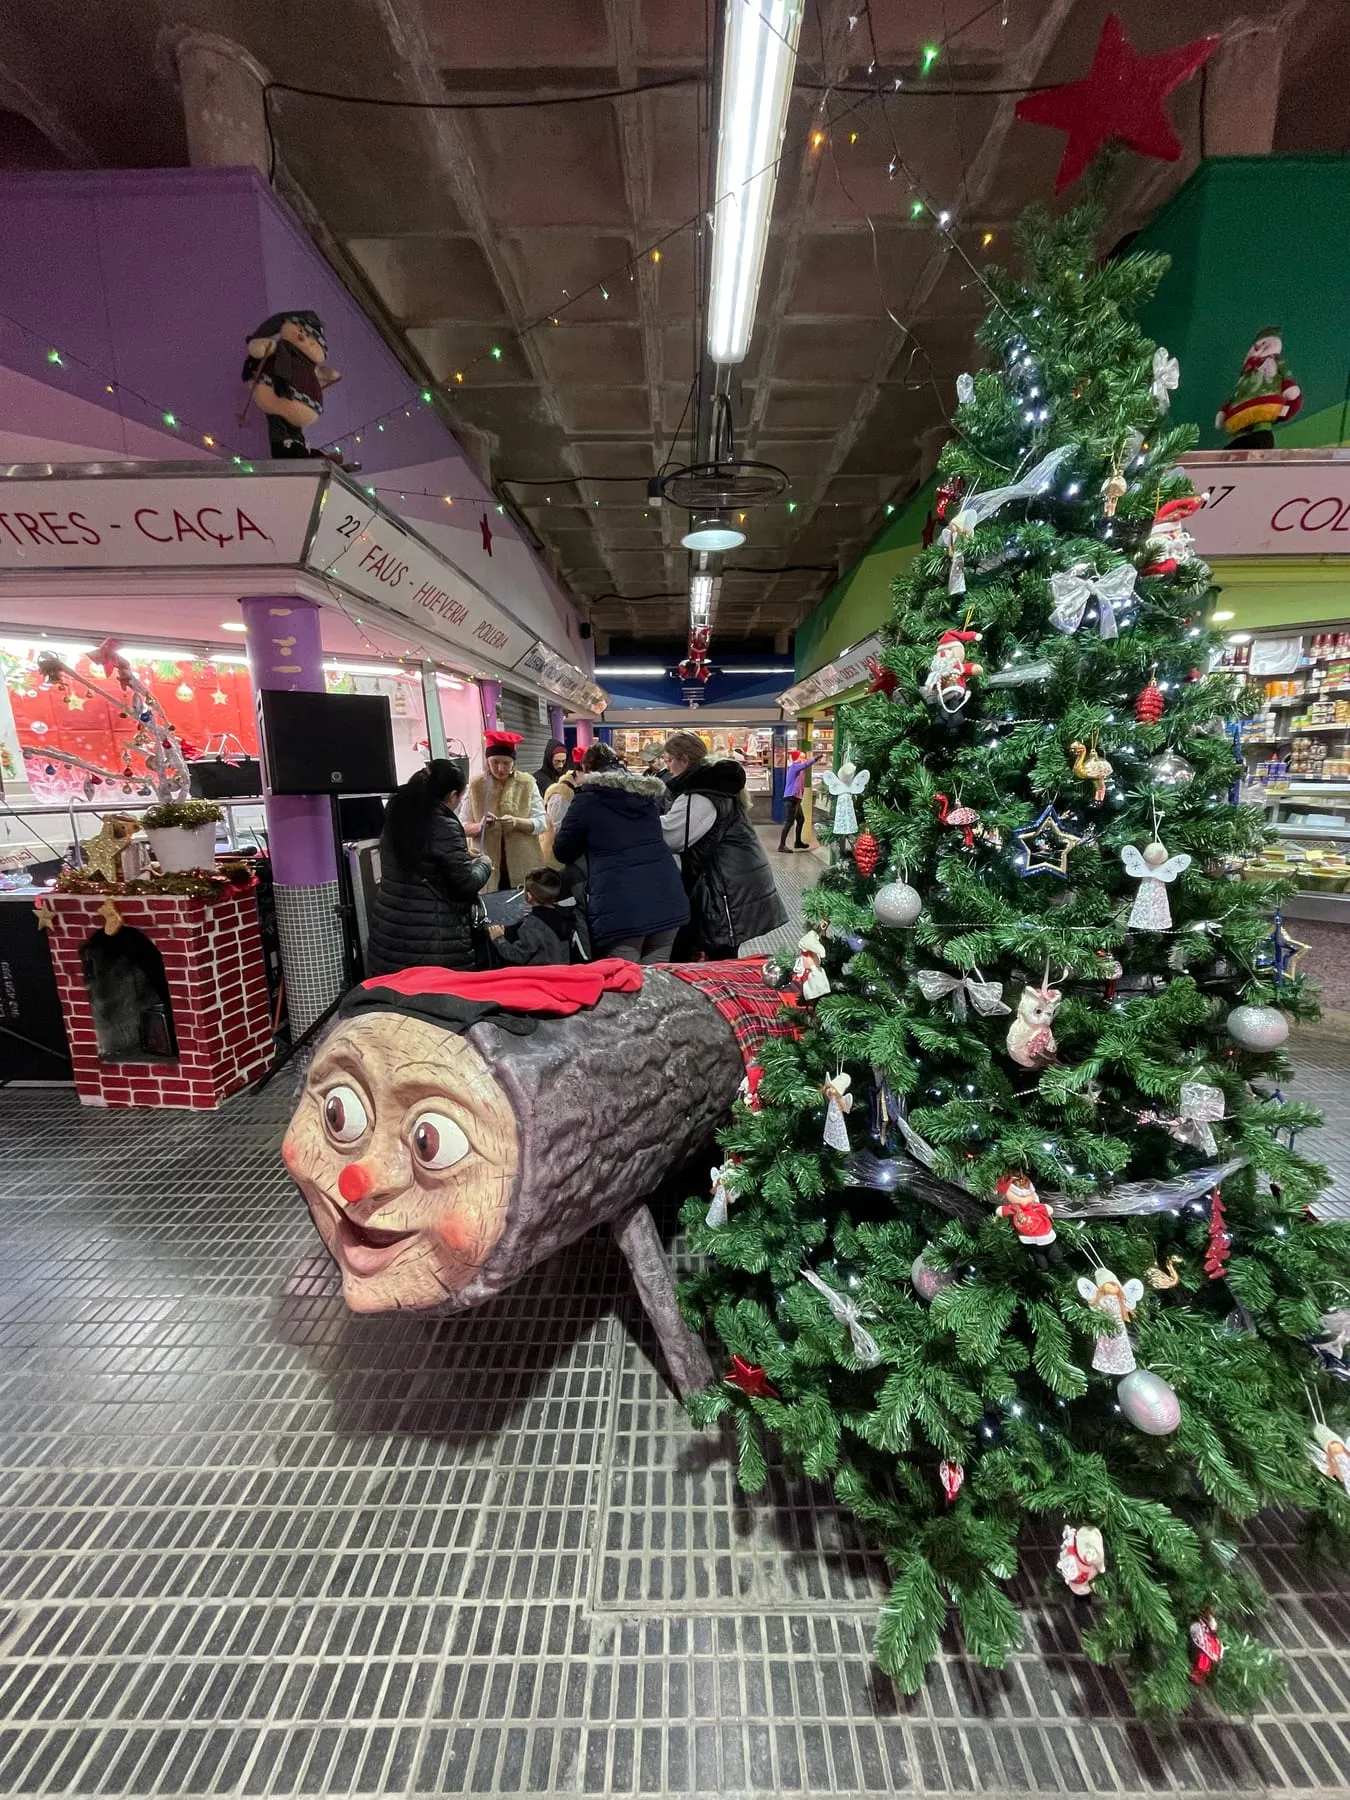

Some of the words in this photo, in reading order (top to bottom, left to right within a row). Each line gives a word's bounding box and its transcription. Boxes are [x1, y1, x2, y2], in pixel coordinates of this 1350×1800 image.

[0, 512, 101, 545] TRES
[134, 507, 269, 548] CAÇA
[1271, 496, 1350, 532] COL
[336, 515, 361, 538] 22
[358, 544, 409, 587] FAUS
[413, 581, 469, 626] HUEVERIA
[473, 620, 509, 650] POLLERIA
